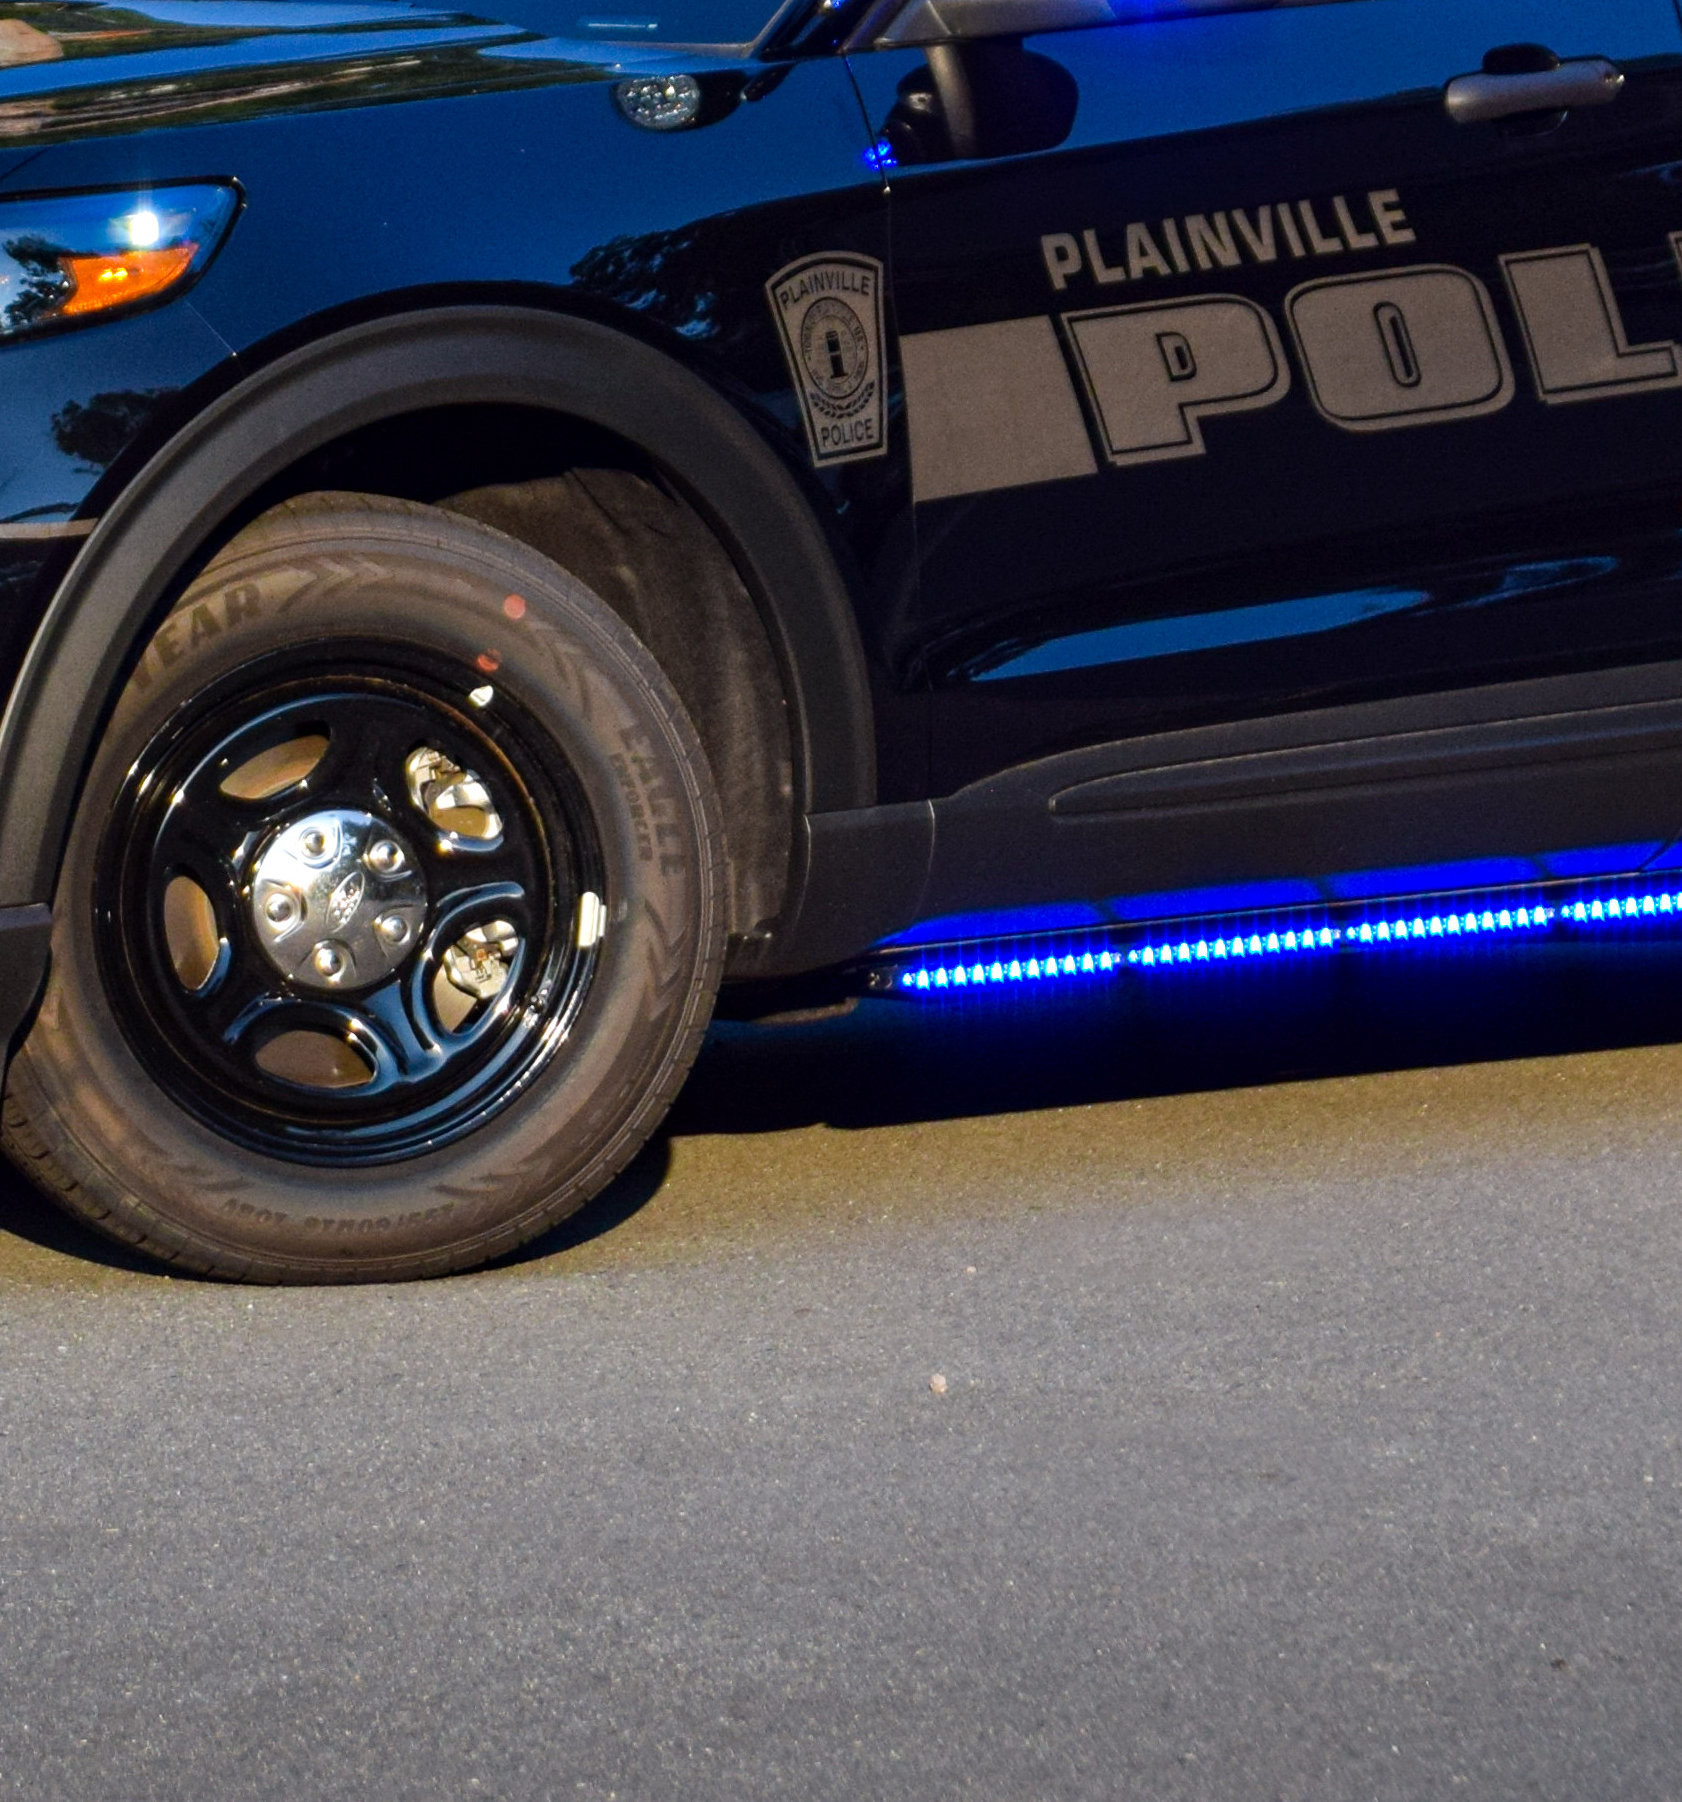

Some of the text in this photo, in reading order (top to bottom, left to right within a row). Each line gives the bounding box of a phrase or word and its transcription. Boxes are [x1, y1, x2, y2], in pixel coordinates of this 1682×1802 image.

[1041, 189, 1417, 291] PLAINVILLE
[780, 270, 872, 311] PLAINVILLE
[820, 417, 874, 447] POLICE
